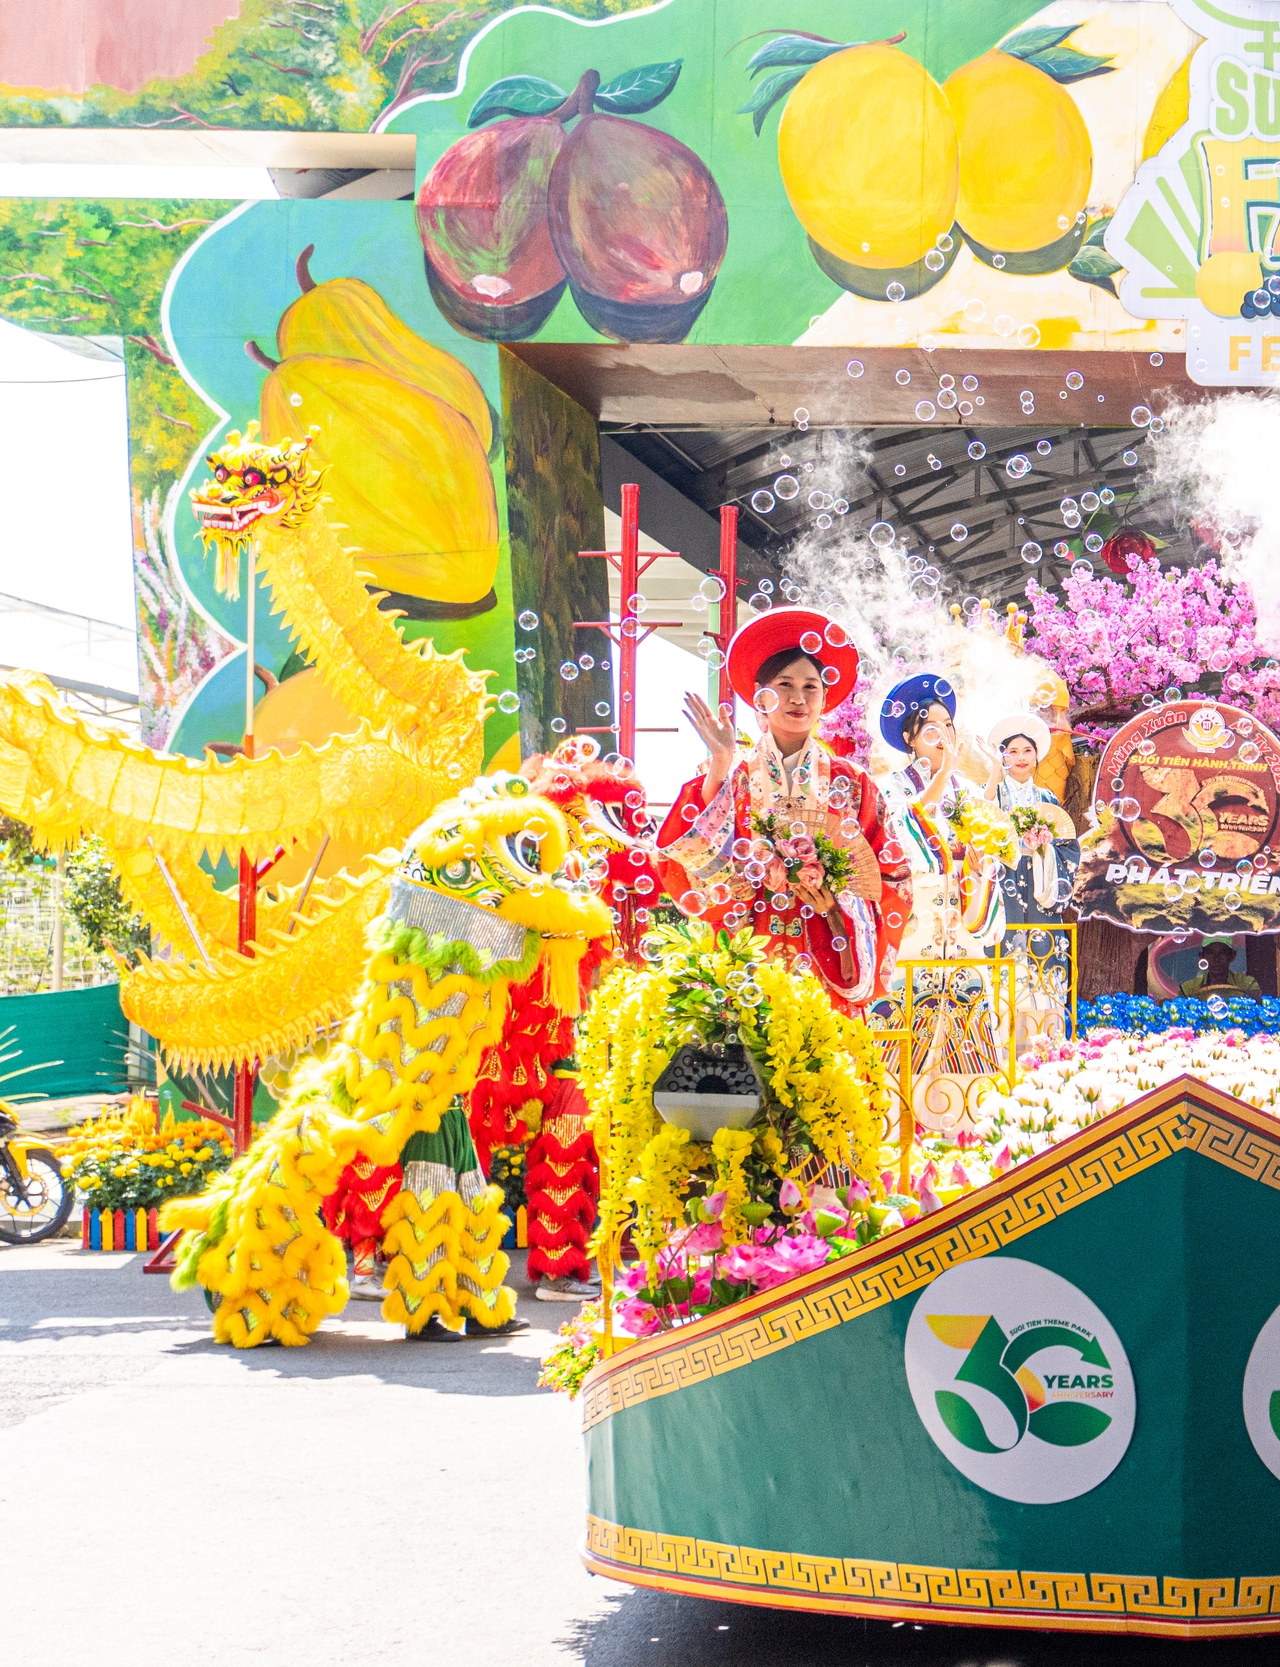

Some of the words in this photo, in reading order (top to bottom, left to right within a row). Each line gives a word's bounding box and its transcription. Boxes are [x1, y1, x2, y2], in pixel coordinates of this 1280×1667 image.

[1108, 731, 1144, 776] Mừng
[1142, 711, 1187, 736] Xuân
[1129, 753, 1160, 765] SUỐI
[1163, 756, 1190, 767] TIÊN
[1192, 757, 1228, 769] HÀNH
[1219, 812, 1269, 827] YEARS
[1105, 863, 1194, 886] PHÁT
[1009, 1324, 1025, 1337] SUOI
[1026, 1319, 1042, 1328] TIEN
[1043, 1318, 1070, 1328] THEME
[1071, 1323, 1092, 1338] PARK
[1043, 1374, 1114, 1389] YEARS
[1051, 1391, 1114, 1399] ANNIVERSARY
